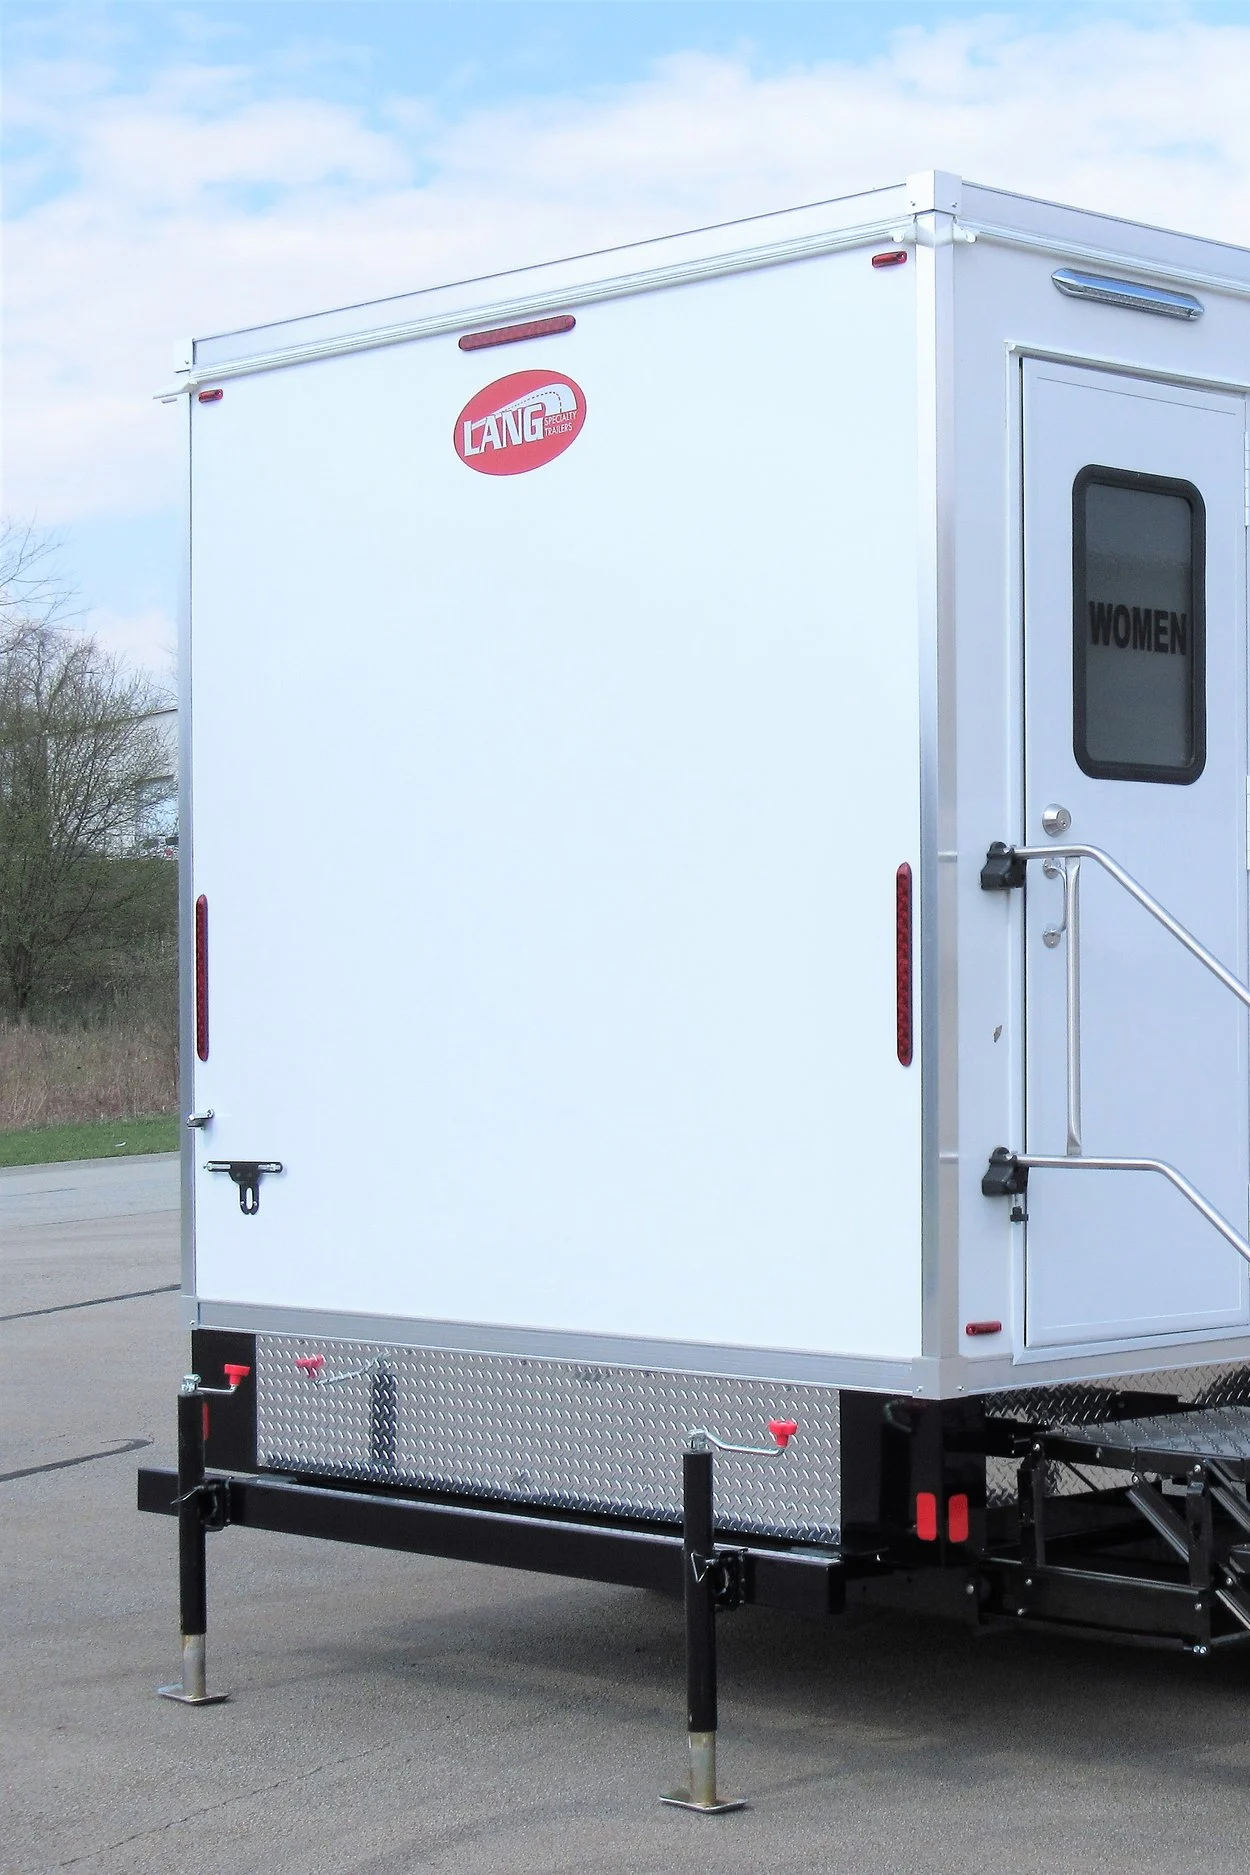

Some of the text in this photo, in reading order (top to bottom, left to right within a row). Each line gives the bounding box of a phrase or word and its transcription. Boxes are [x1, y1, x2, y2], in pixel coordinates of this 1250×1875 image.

[464, 403, 544, 457] LANG
[544, 411, 577, 426] SPECIALTY
[544, 422, 573, 437] TRAILERS
[1088, 601, 1187, 656] WOMEN
